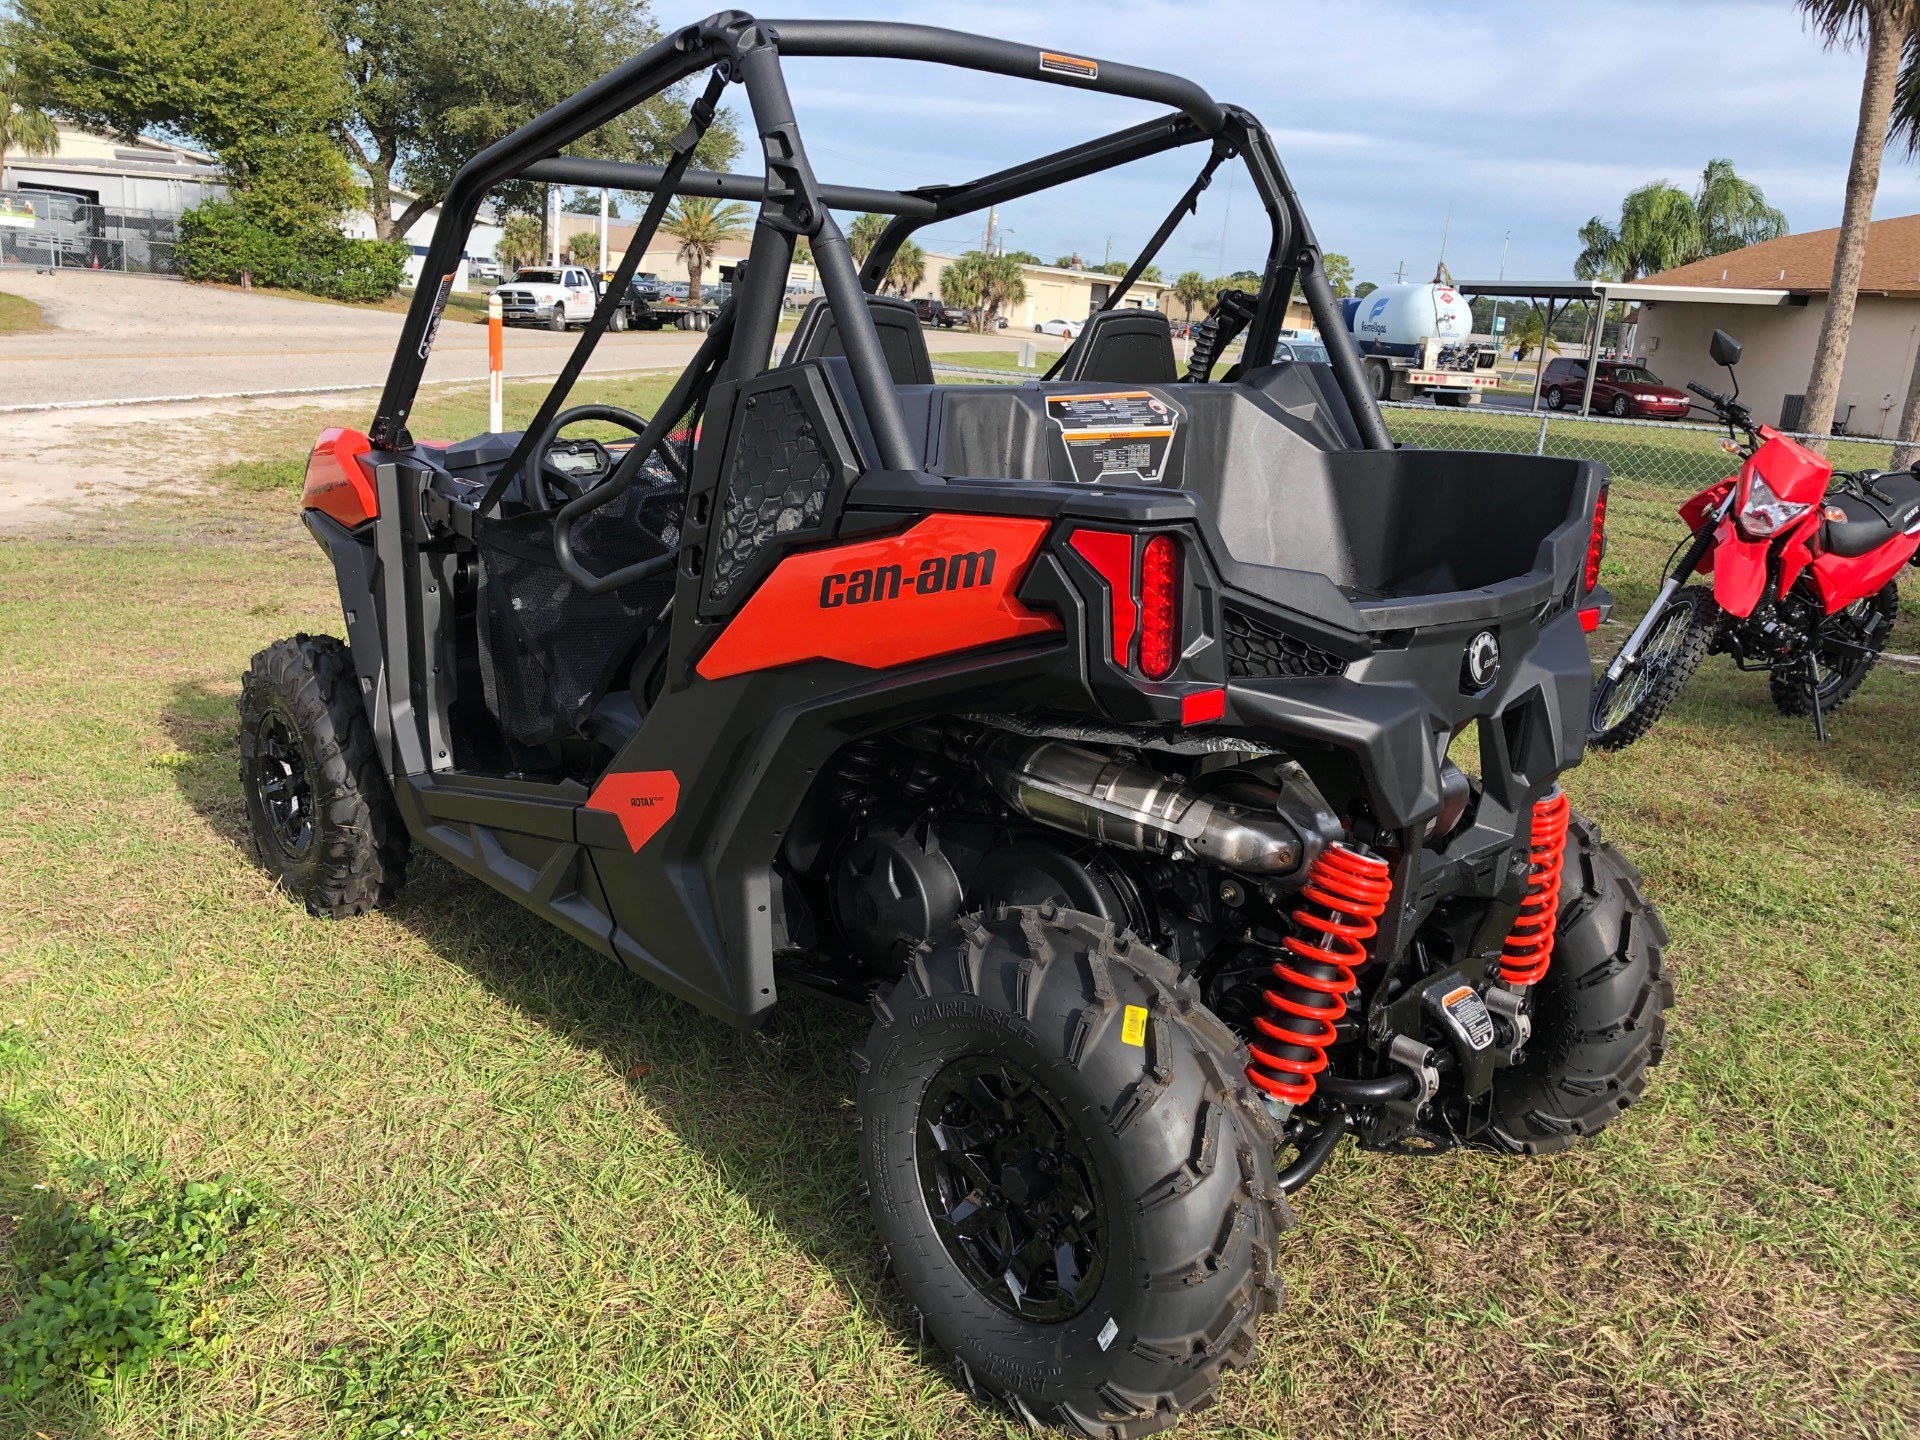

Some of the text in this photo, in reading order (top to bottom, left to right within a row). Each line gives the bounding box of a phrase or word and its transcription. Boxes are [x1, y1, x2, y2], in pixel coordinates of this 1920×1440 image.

[1361, 320, 1387, 335] Ferrellgas
[819, 548, 997, 609] can-am
[1483, 656, 1499, 669] BRP
[630, 797, 654, 807] ROTAX
[910, 1000, 1039, 1048] CARLISLE
